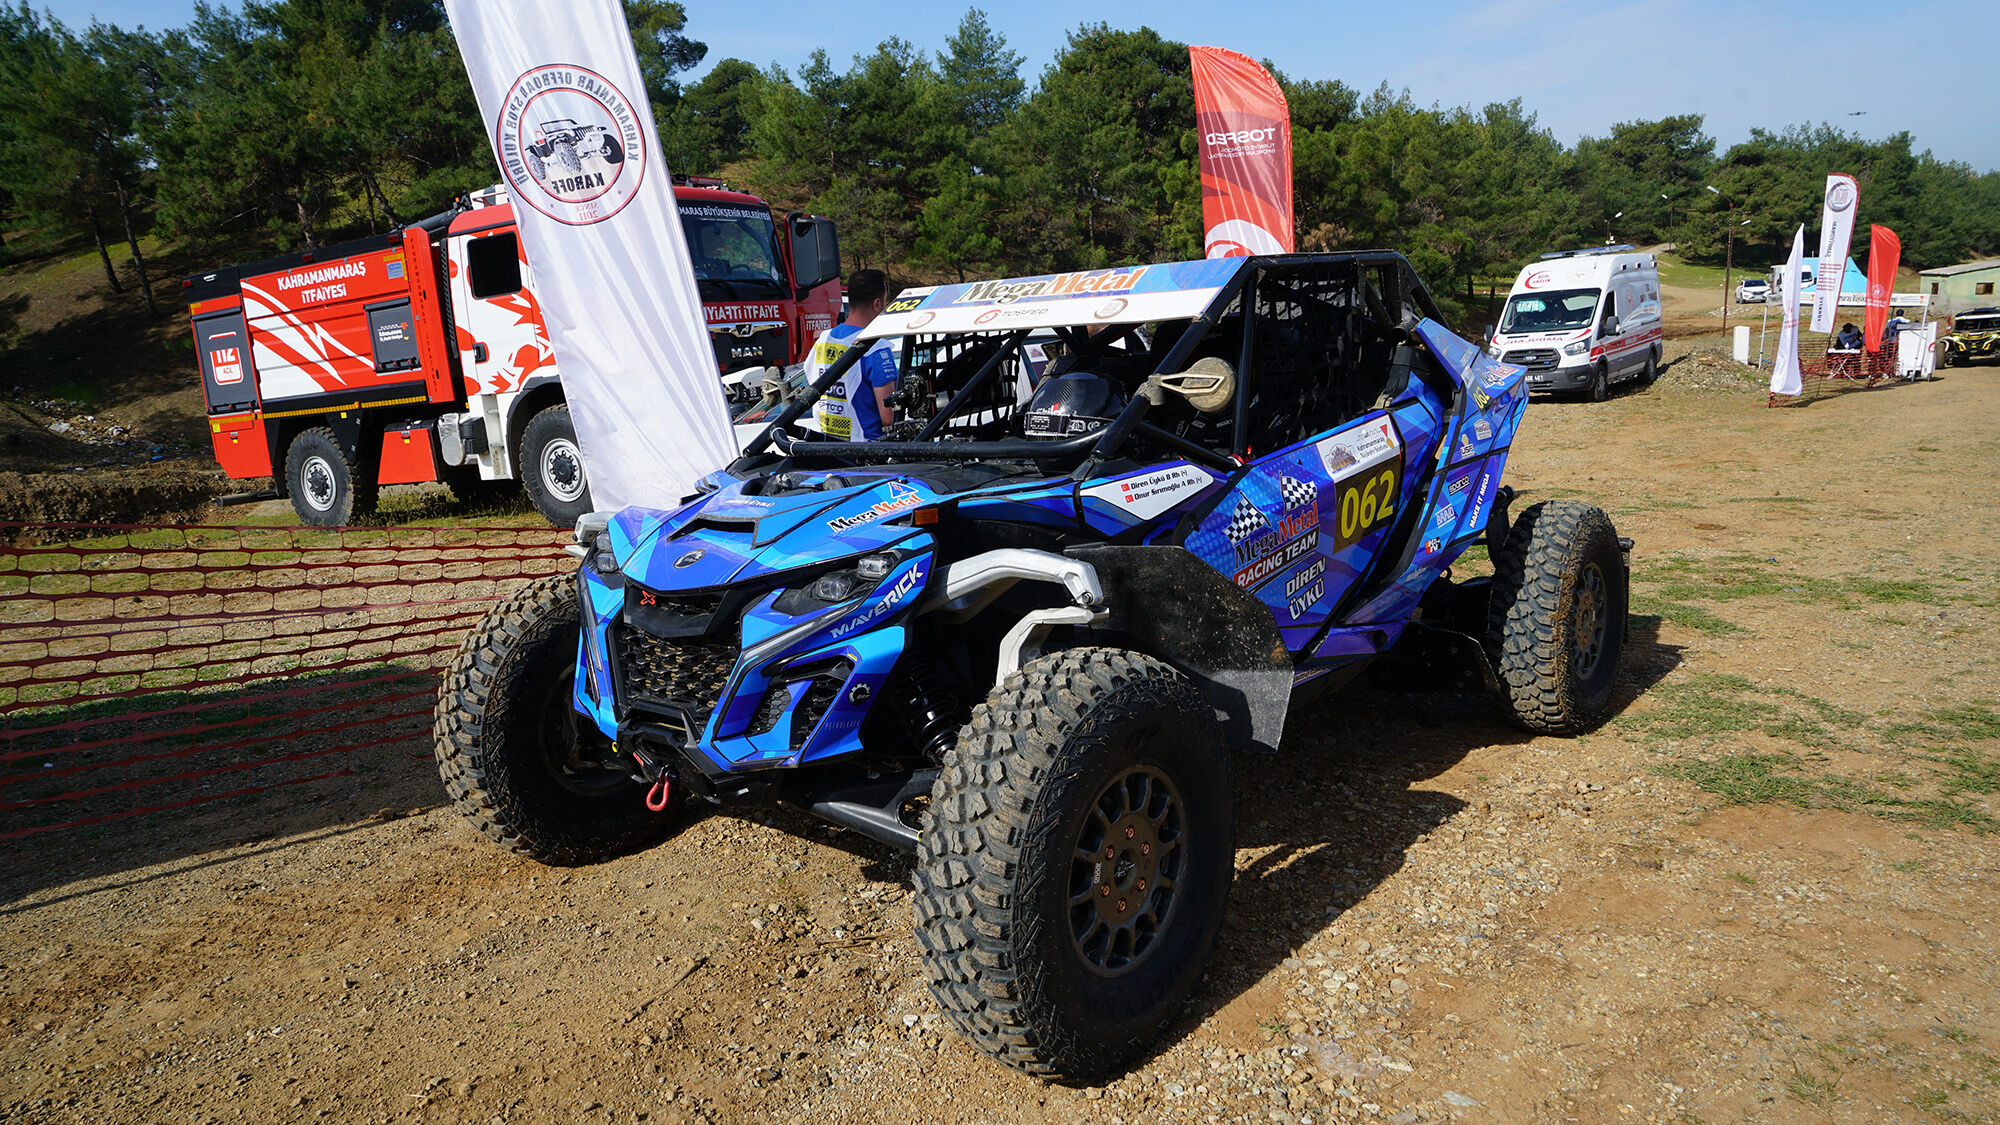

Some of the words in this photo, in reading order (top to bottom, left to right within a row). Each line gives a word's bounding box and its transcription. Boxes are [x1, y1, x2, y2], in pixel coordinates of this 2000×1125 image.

[703, 205, 741, 217] BÜYÜKŞEHİR
[277, 261, 366, 291] KAHRAMANMARAŞ
[955, 267, 1150, 304] MegaMetal
[301, 283, 347, 304] İTFAİYESİ
[743, 305, 780, 319] İTFAİYE
[885, 299, 922, 313] 062
[1002, 308, 1048, 317] TOSFED
[731, 346, 763, 358] MAN
[1472, 385, 1491, 409] 062
[1131, 480, 1148, 490] Diren
[1149, 476, 1166, 485] Üykü
[1134, 491, 1150, 500] Onur
[1187, 478, 1195, 486] Rh
[1449, 475, 1470, 494] sparco
[1480, 473, 1491, 496] MEGA
[1341, 470, 1395, 539] 062
[1477, 495, 1484, 505] IT
[827, 493, 924, 533] MegaMetal
[1469, 504, 1481, 529] MAKE
[1234, 500, 1319, 570] MegaMetal
[1238, 551, 1283, 587] RACING
[1285, 531, 1317, 560] TEAM
[1285, 556, 1327, 600] DİREN
[830, 562, 924, 639] MAVERICK
[1287, 577, 1325, 621] ÜYKÜ
